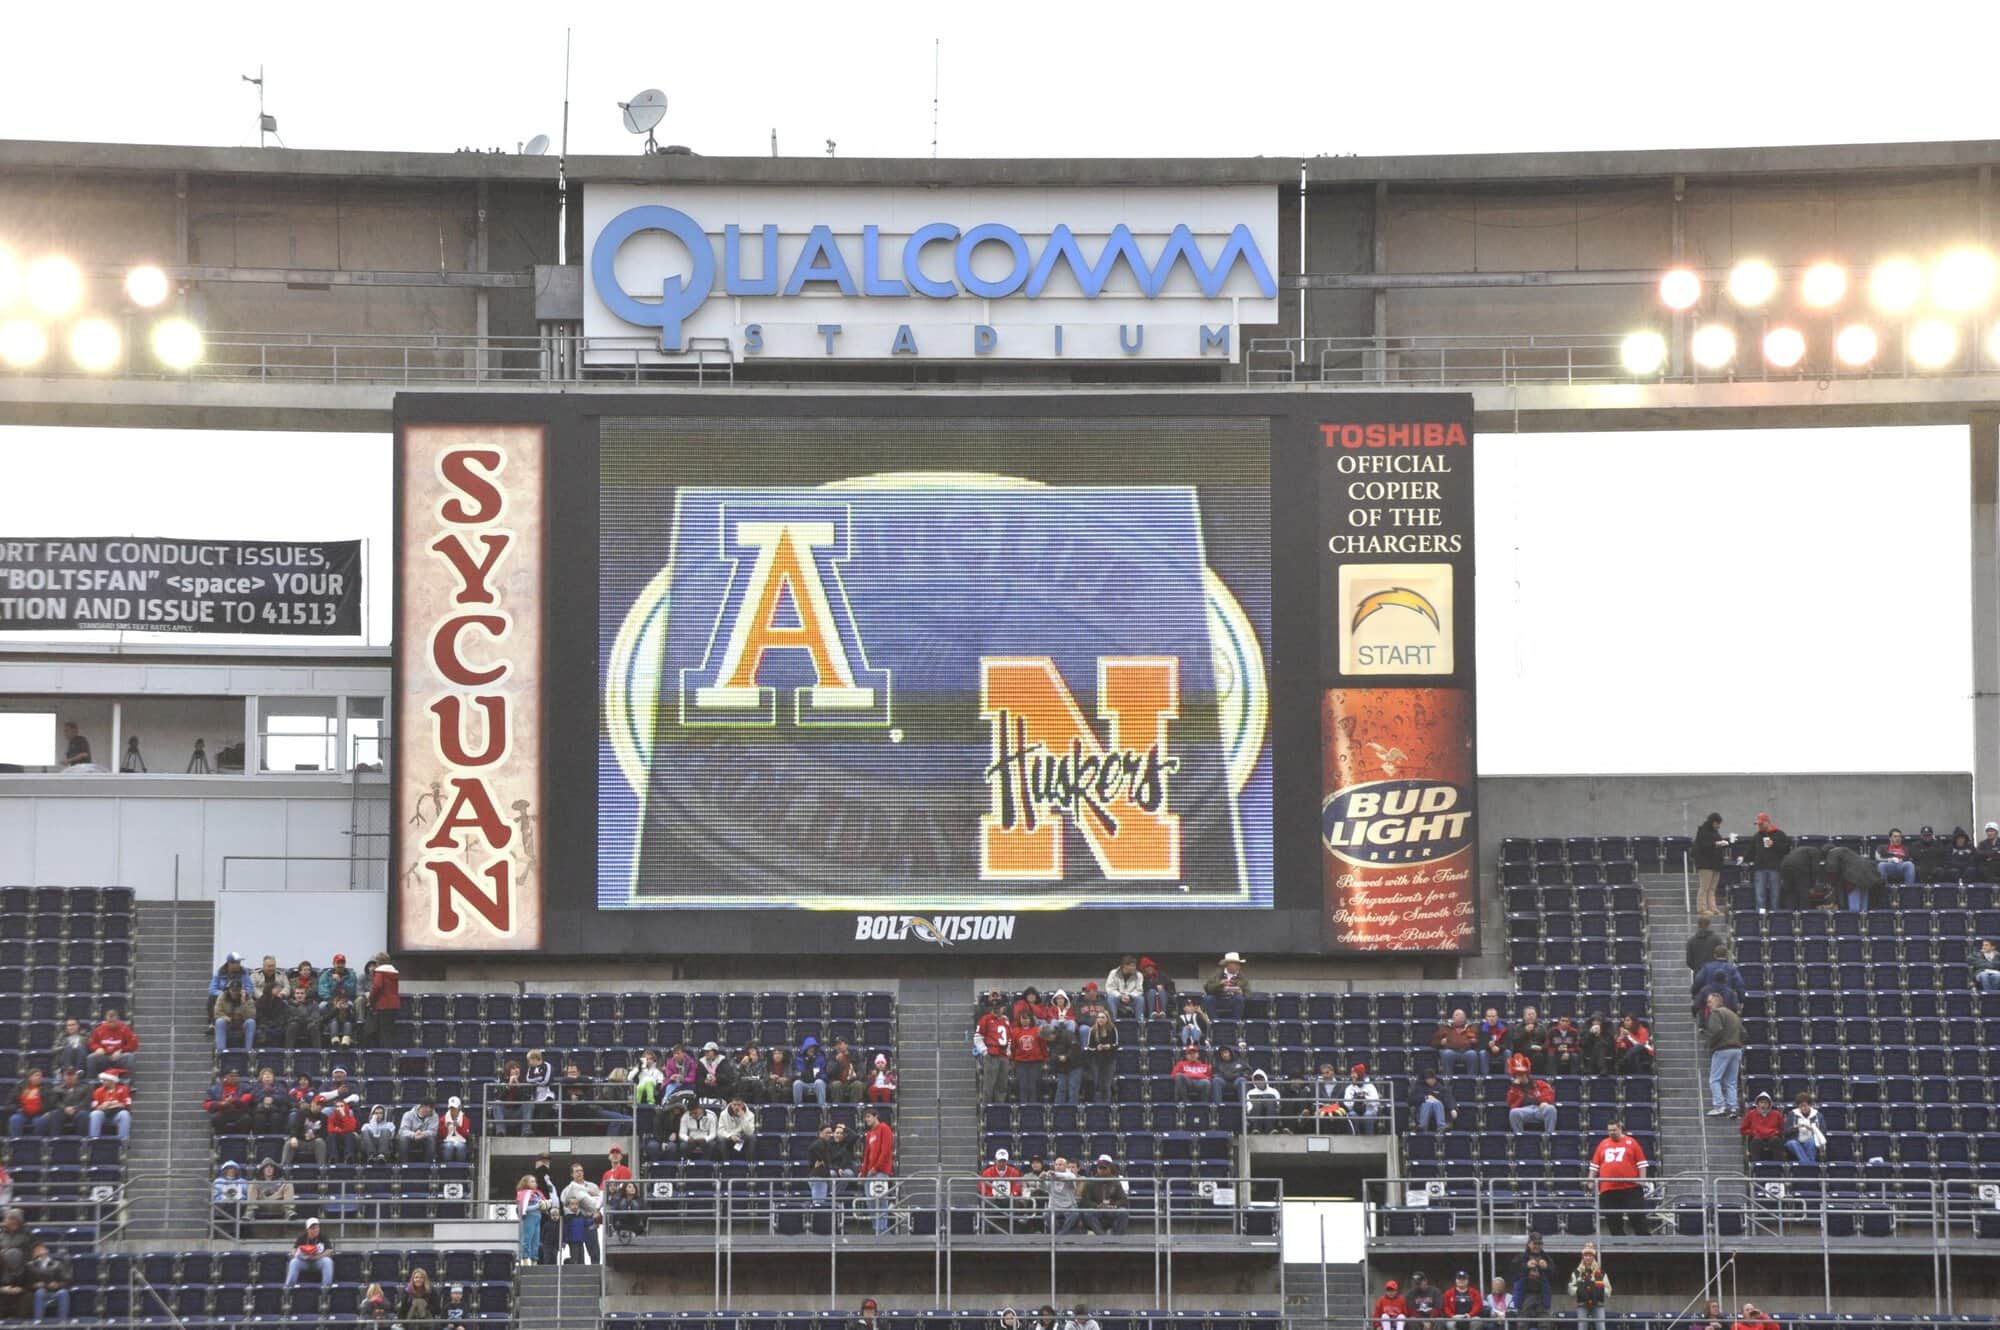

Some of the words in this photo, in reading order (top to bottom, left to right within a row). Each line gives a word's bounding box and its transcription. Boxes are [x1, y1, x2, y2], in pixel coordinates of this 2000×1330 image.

[591, 204, 1278, 352] QUALCOMM
[744, 324, 1231, 355] STADIUM
[1319, 422, 1467, 448] TOSHIBA
[1337, 454, 1452, 474] OFFICIAL
[1348, 481, 1443, 501] COPIER
[1348, 508, 1382, 527] OF
[1389, 508, 1443, 527] THE
[47, 542, 98, 562] FAN
[105, 542, 230, 566] CONDUCT
[236, 546, 331, 570] ISSUES,
[1328, 534, 1462, 554] CHARGERS
[166, 575, 266, 598] <space>
[272, 572, 344, 596] YOUR
[0, 597, 67, 620] TION
[73, 597, 131, 620] AND
[138, 598, 215, 622] ISSUE
[221, 600, 256, 624] TO
[262, 602, 337, 625] 41513
[680, 503, 891, 726] A
[1358, 644, 1437, 665] START
[424, 449, 512, 933] SYCUAN
[980, 656, 1180, 879] N
[986, 708, 1180, 836] Huskers
[1346, 786, 1458, 818] BUD
[1330, 811, 1472, 846] LIGHT
[1370, 847, 1432, 861] BEER
[1336, 873, 1383, 888] Brewed
[1384, 874, 1410, 887] with
[1412, 870, 1430, 885] the
[1432, 868, 1470, 883] Finest
[1348, 890, 1425, 908] Ingredients
[1423, 889, 1447, 906] for
[1447, 891, 1458, 899] a
[855, 915, 913, 940] BOLT
[932, 915, 1016, 940] VISION
[1332, 908, 1400, 927] Refreshingly
[1403, 906, 1451, 921] Smooth
[1604, 1146, 1626, 1163] 67
